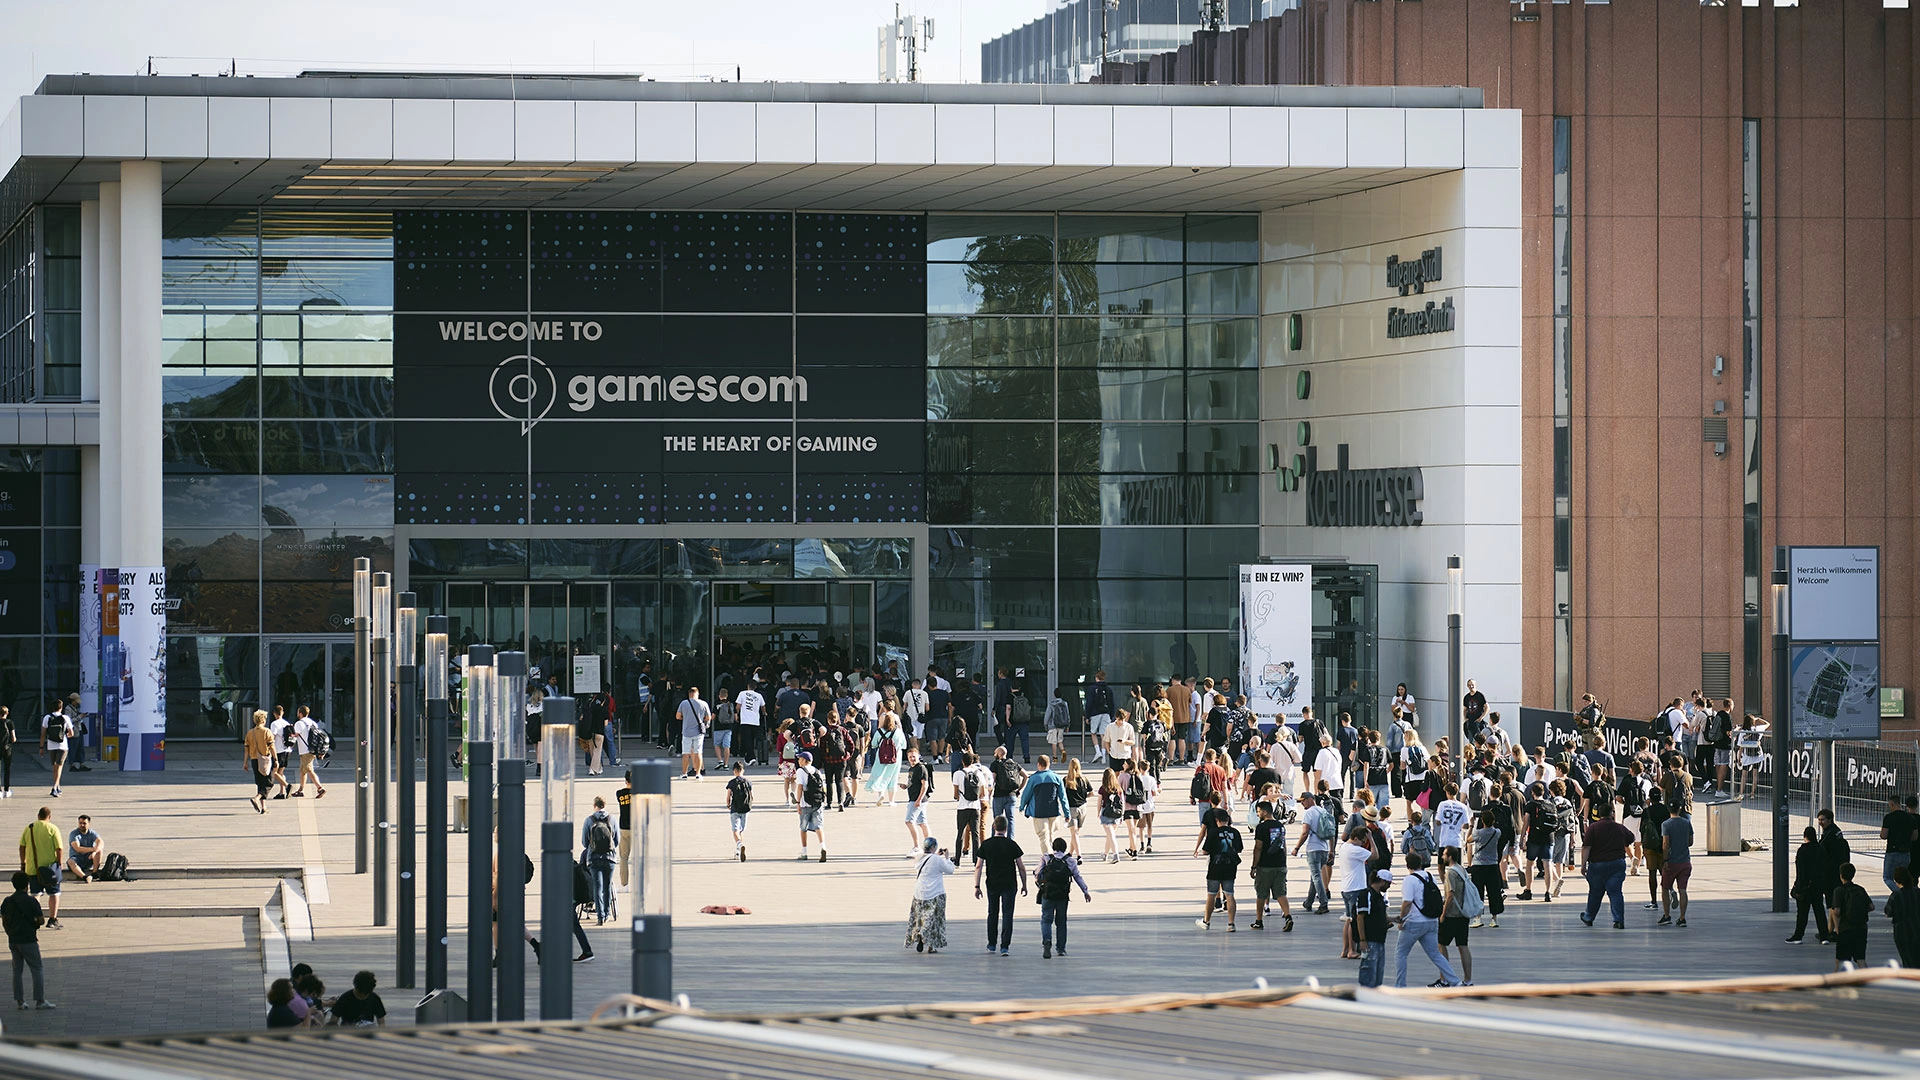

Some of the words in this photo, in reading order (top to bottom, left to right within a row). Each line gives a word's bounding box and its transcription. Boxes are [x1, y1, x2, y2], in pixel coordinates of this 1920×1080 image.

[1387, 254, 1424, 296] Eingang
[1421, 246, 1442, 283] Süd
[1387, 304, 1427, 338] Entrance
[1424, 296, 1455, 335] South
[439, 321, 563, 341] WELCOME
[570, 321, 603, 341] TO
[568, 375, 808, 412] gamescom
[664, 436, 696, 451] THE
[702, 436, 761, 451] HEART
[766, 436, 791, 451] OF
[796, 436, 877, 452] GAMING
[1306, 443, 1424, 527] koelnmesse
[148, 572, 164, 585] ALS
[1255, 572, 1268, 582] EIN
[1270, 572, 1280, 582] EZ
[1282, 572, 1304, 582] WIN?
[1829, 566, 1872, 574] willkommen
[1797, 577, 1830, 585] Welcome
[1555, 727, 1583, 748] PayPa
[1605, 726, 1660, 756] Welcm
[1860, 764, 1897, 788] PayPal
[1443, 809, 1463, 826] 97
